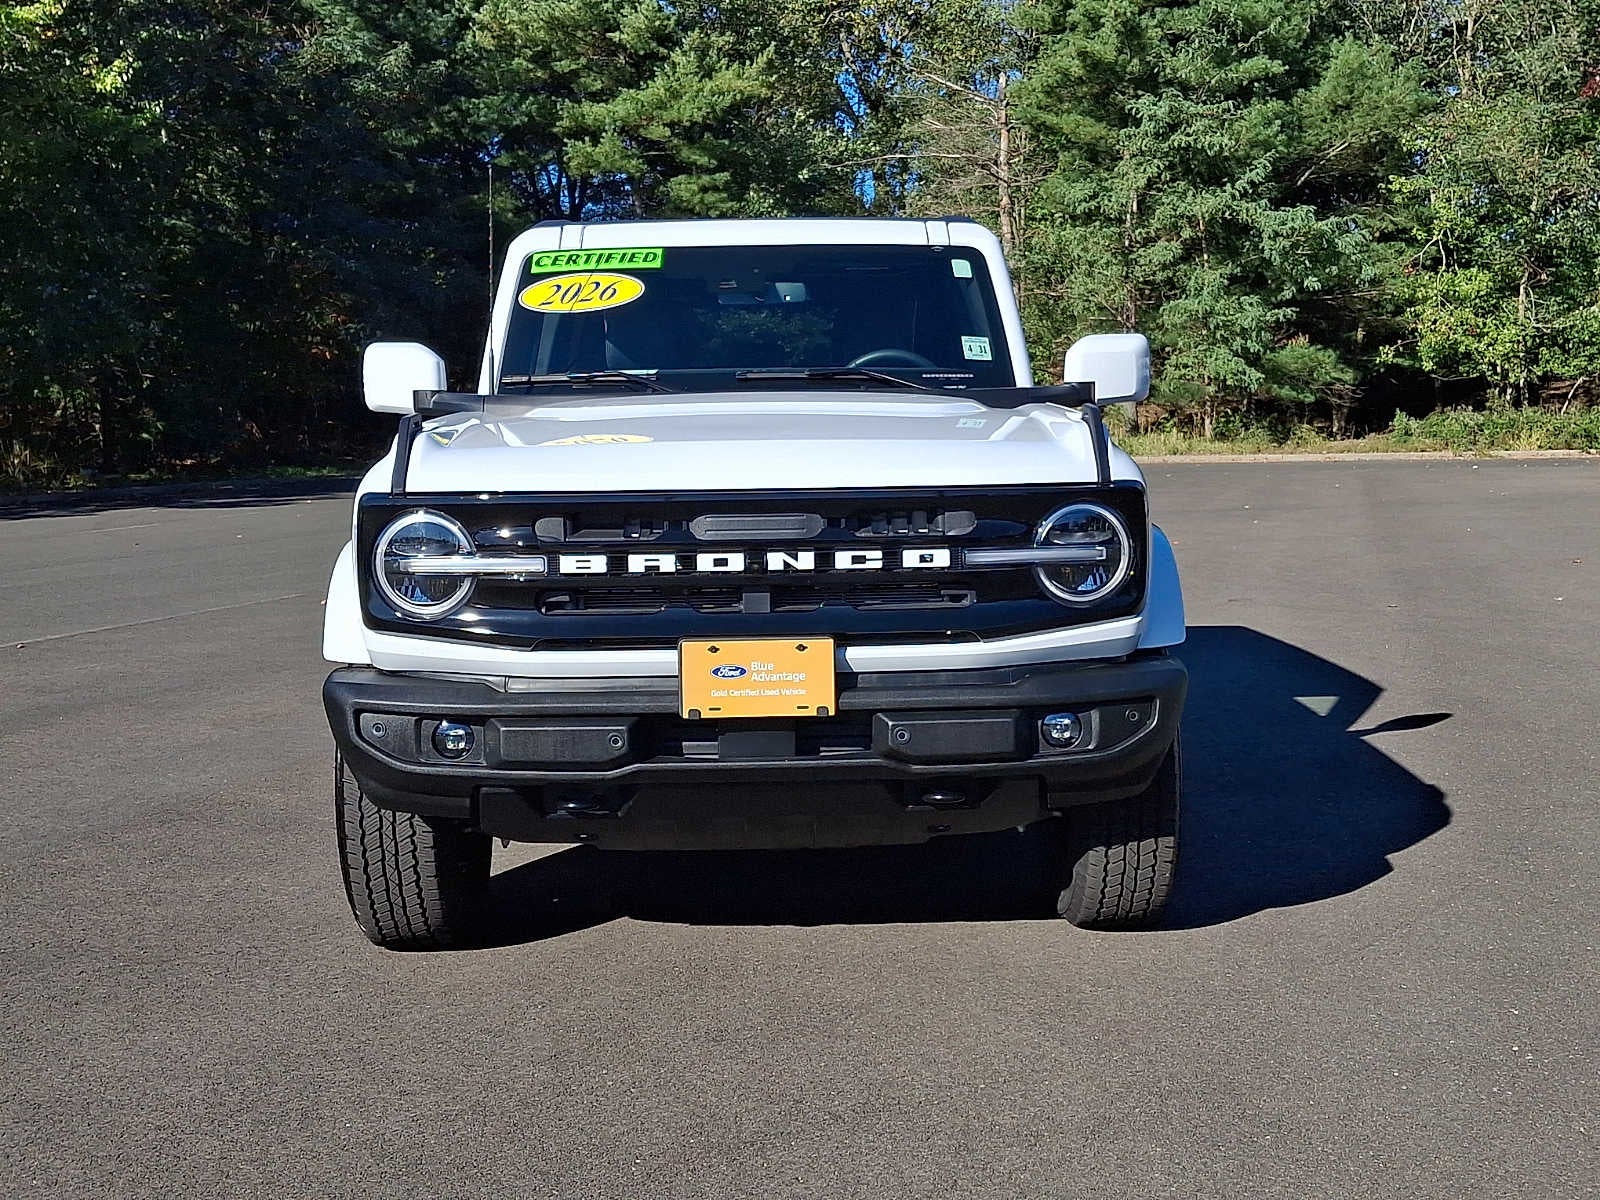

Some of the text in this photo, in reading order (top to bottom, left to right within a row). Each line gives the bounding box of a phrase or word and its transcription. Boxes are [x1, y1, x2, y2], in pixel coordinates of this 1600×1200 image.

[534, 251, 659, 268] CERTIFIED
[538, 280, 621, 306] 2026
[559, 549, 951, 574] BRONCO
[717, 665, 742, 677] Ford
[751, 661, 774, 671] Blue
[751, 671, 806, 682] Advantage
[711, 688, 807, 697] Gold Certified Used Vehicle
